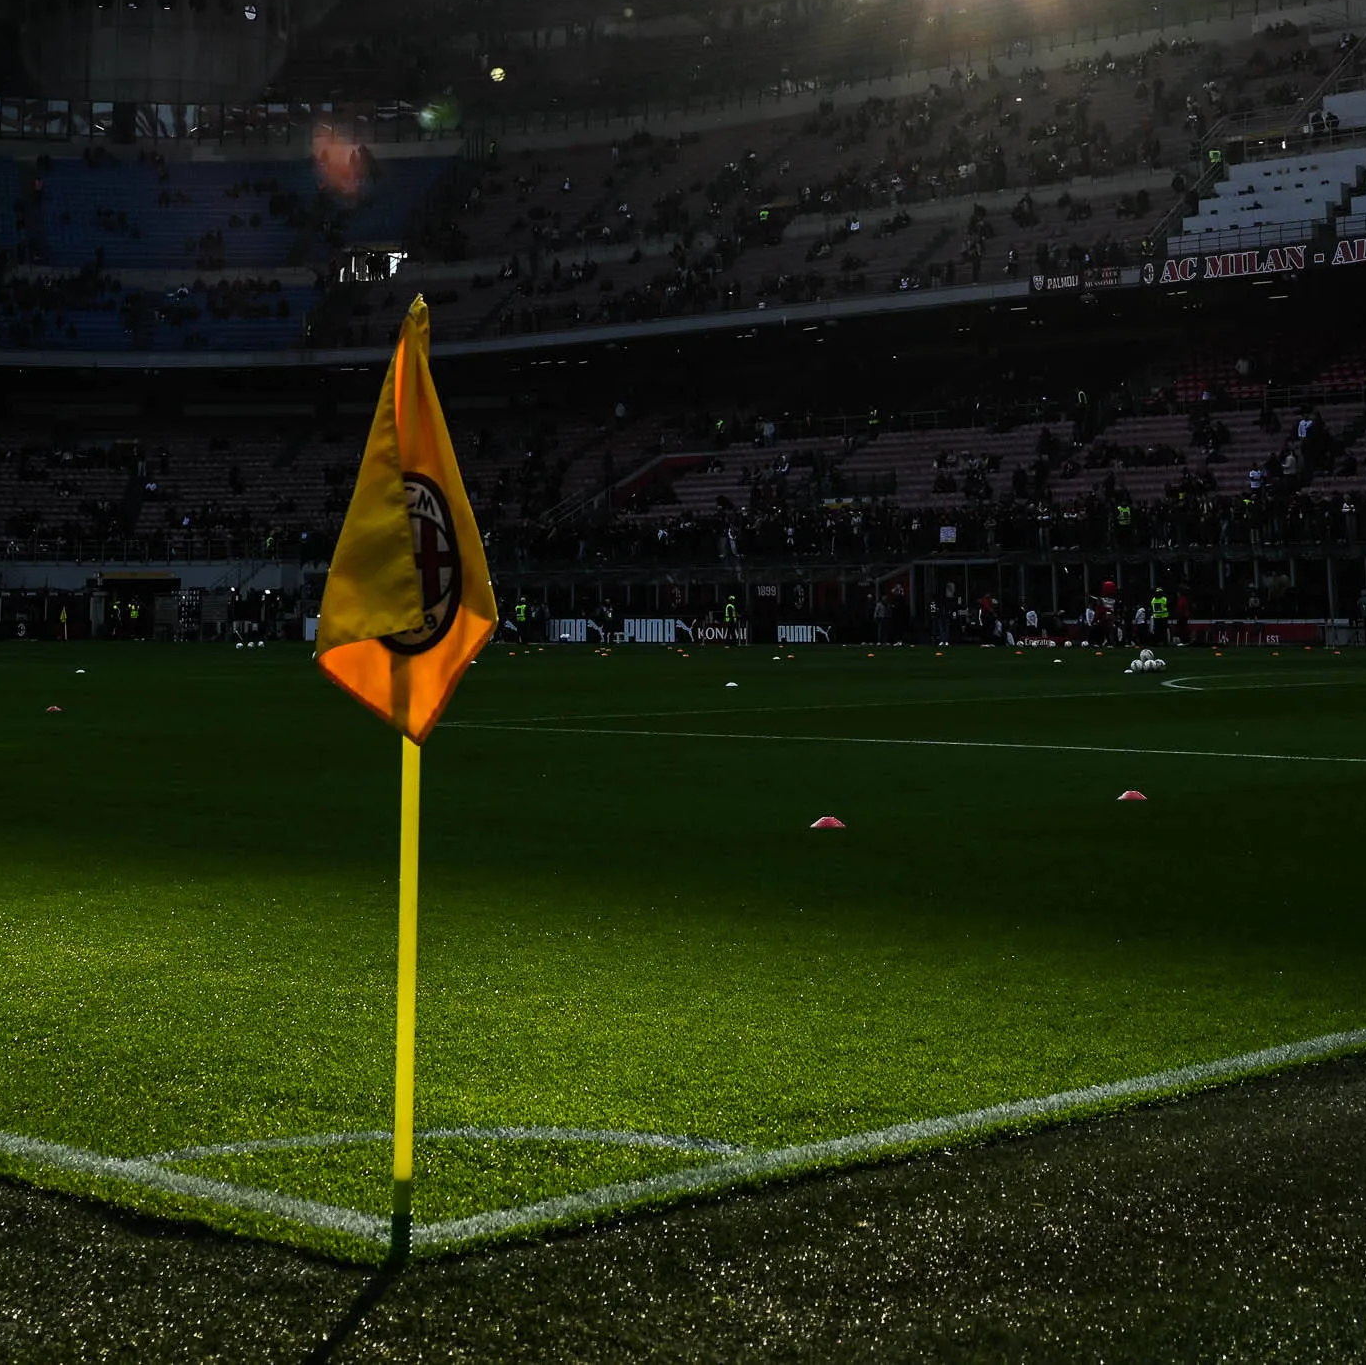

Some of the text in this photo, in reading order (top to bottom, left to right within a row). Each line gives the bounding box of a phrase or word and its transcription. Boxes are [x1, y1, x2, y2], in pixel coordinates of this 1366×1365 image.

[1160, 258, 1197, 283] AC
[1204, 245, 1307, 279] MILAN
[757, 585, 776, 597] 1899
[624, 619, 675, 643] PUMA
